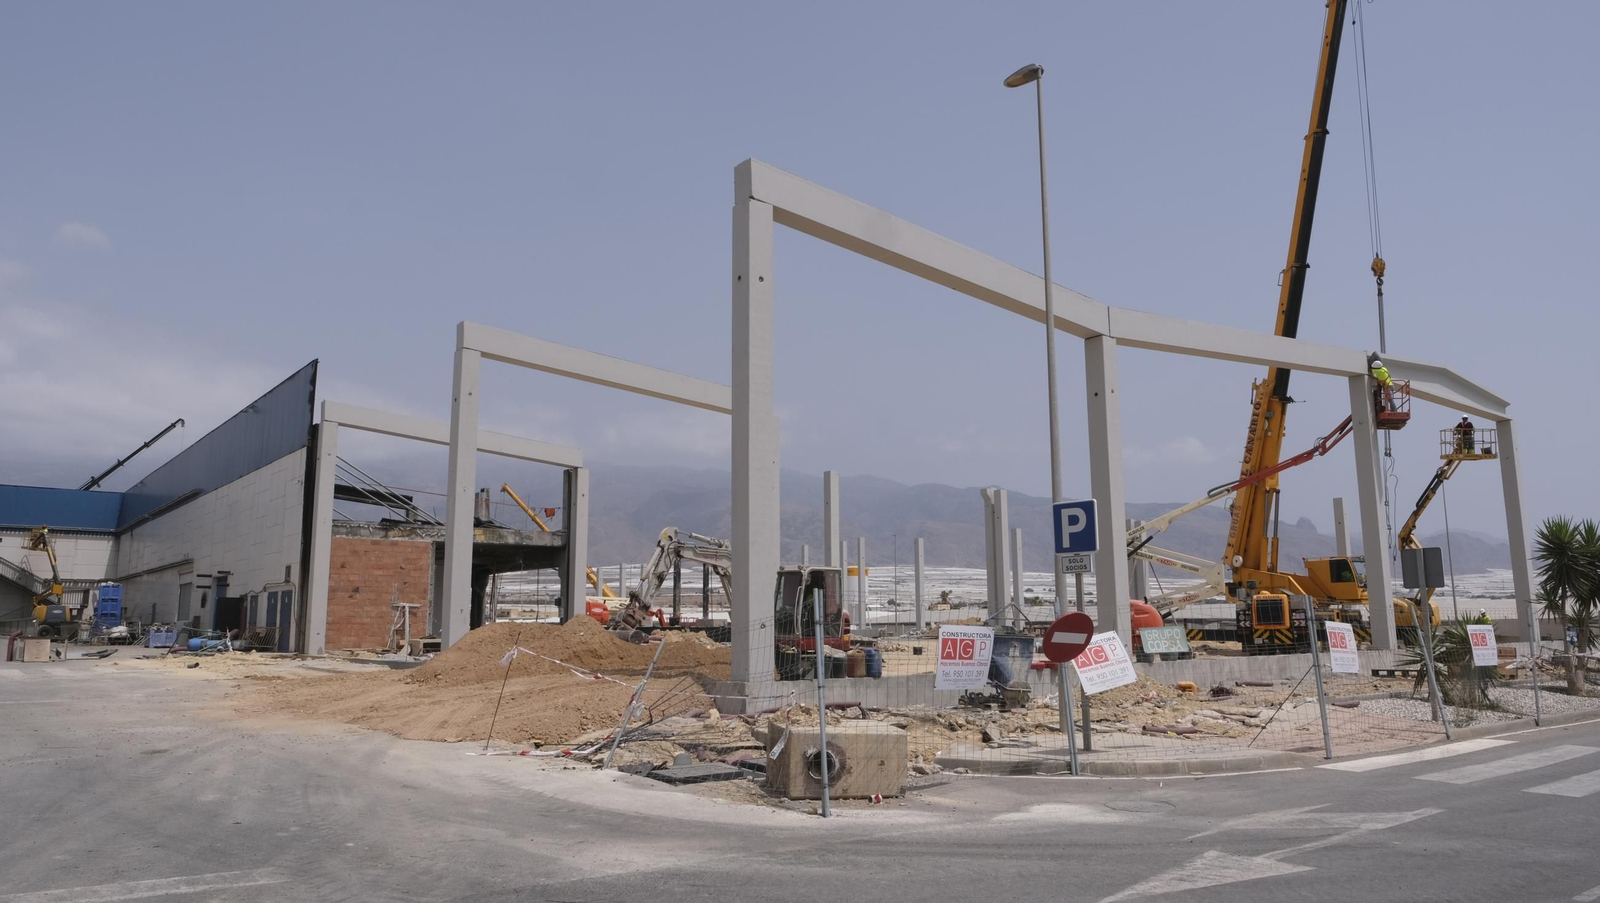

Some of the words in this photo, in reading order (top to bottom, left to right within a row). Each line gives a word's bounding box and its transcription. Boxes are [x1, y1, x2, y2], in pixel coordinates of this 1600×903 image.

[1061, 507, 1087, 549] P
[941, 631, 992, 639] CONSTRUCTORA
[1145, 629, 1181, 640] GRUPO
[1147, 640, 1184, 651] COPSA
[953, 670, 964, 678] 950
[965, 670, 974, 678] 101
[975, 670, 985, 678] 391
